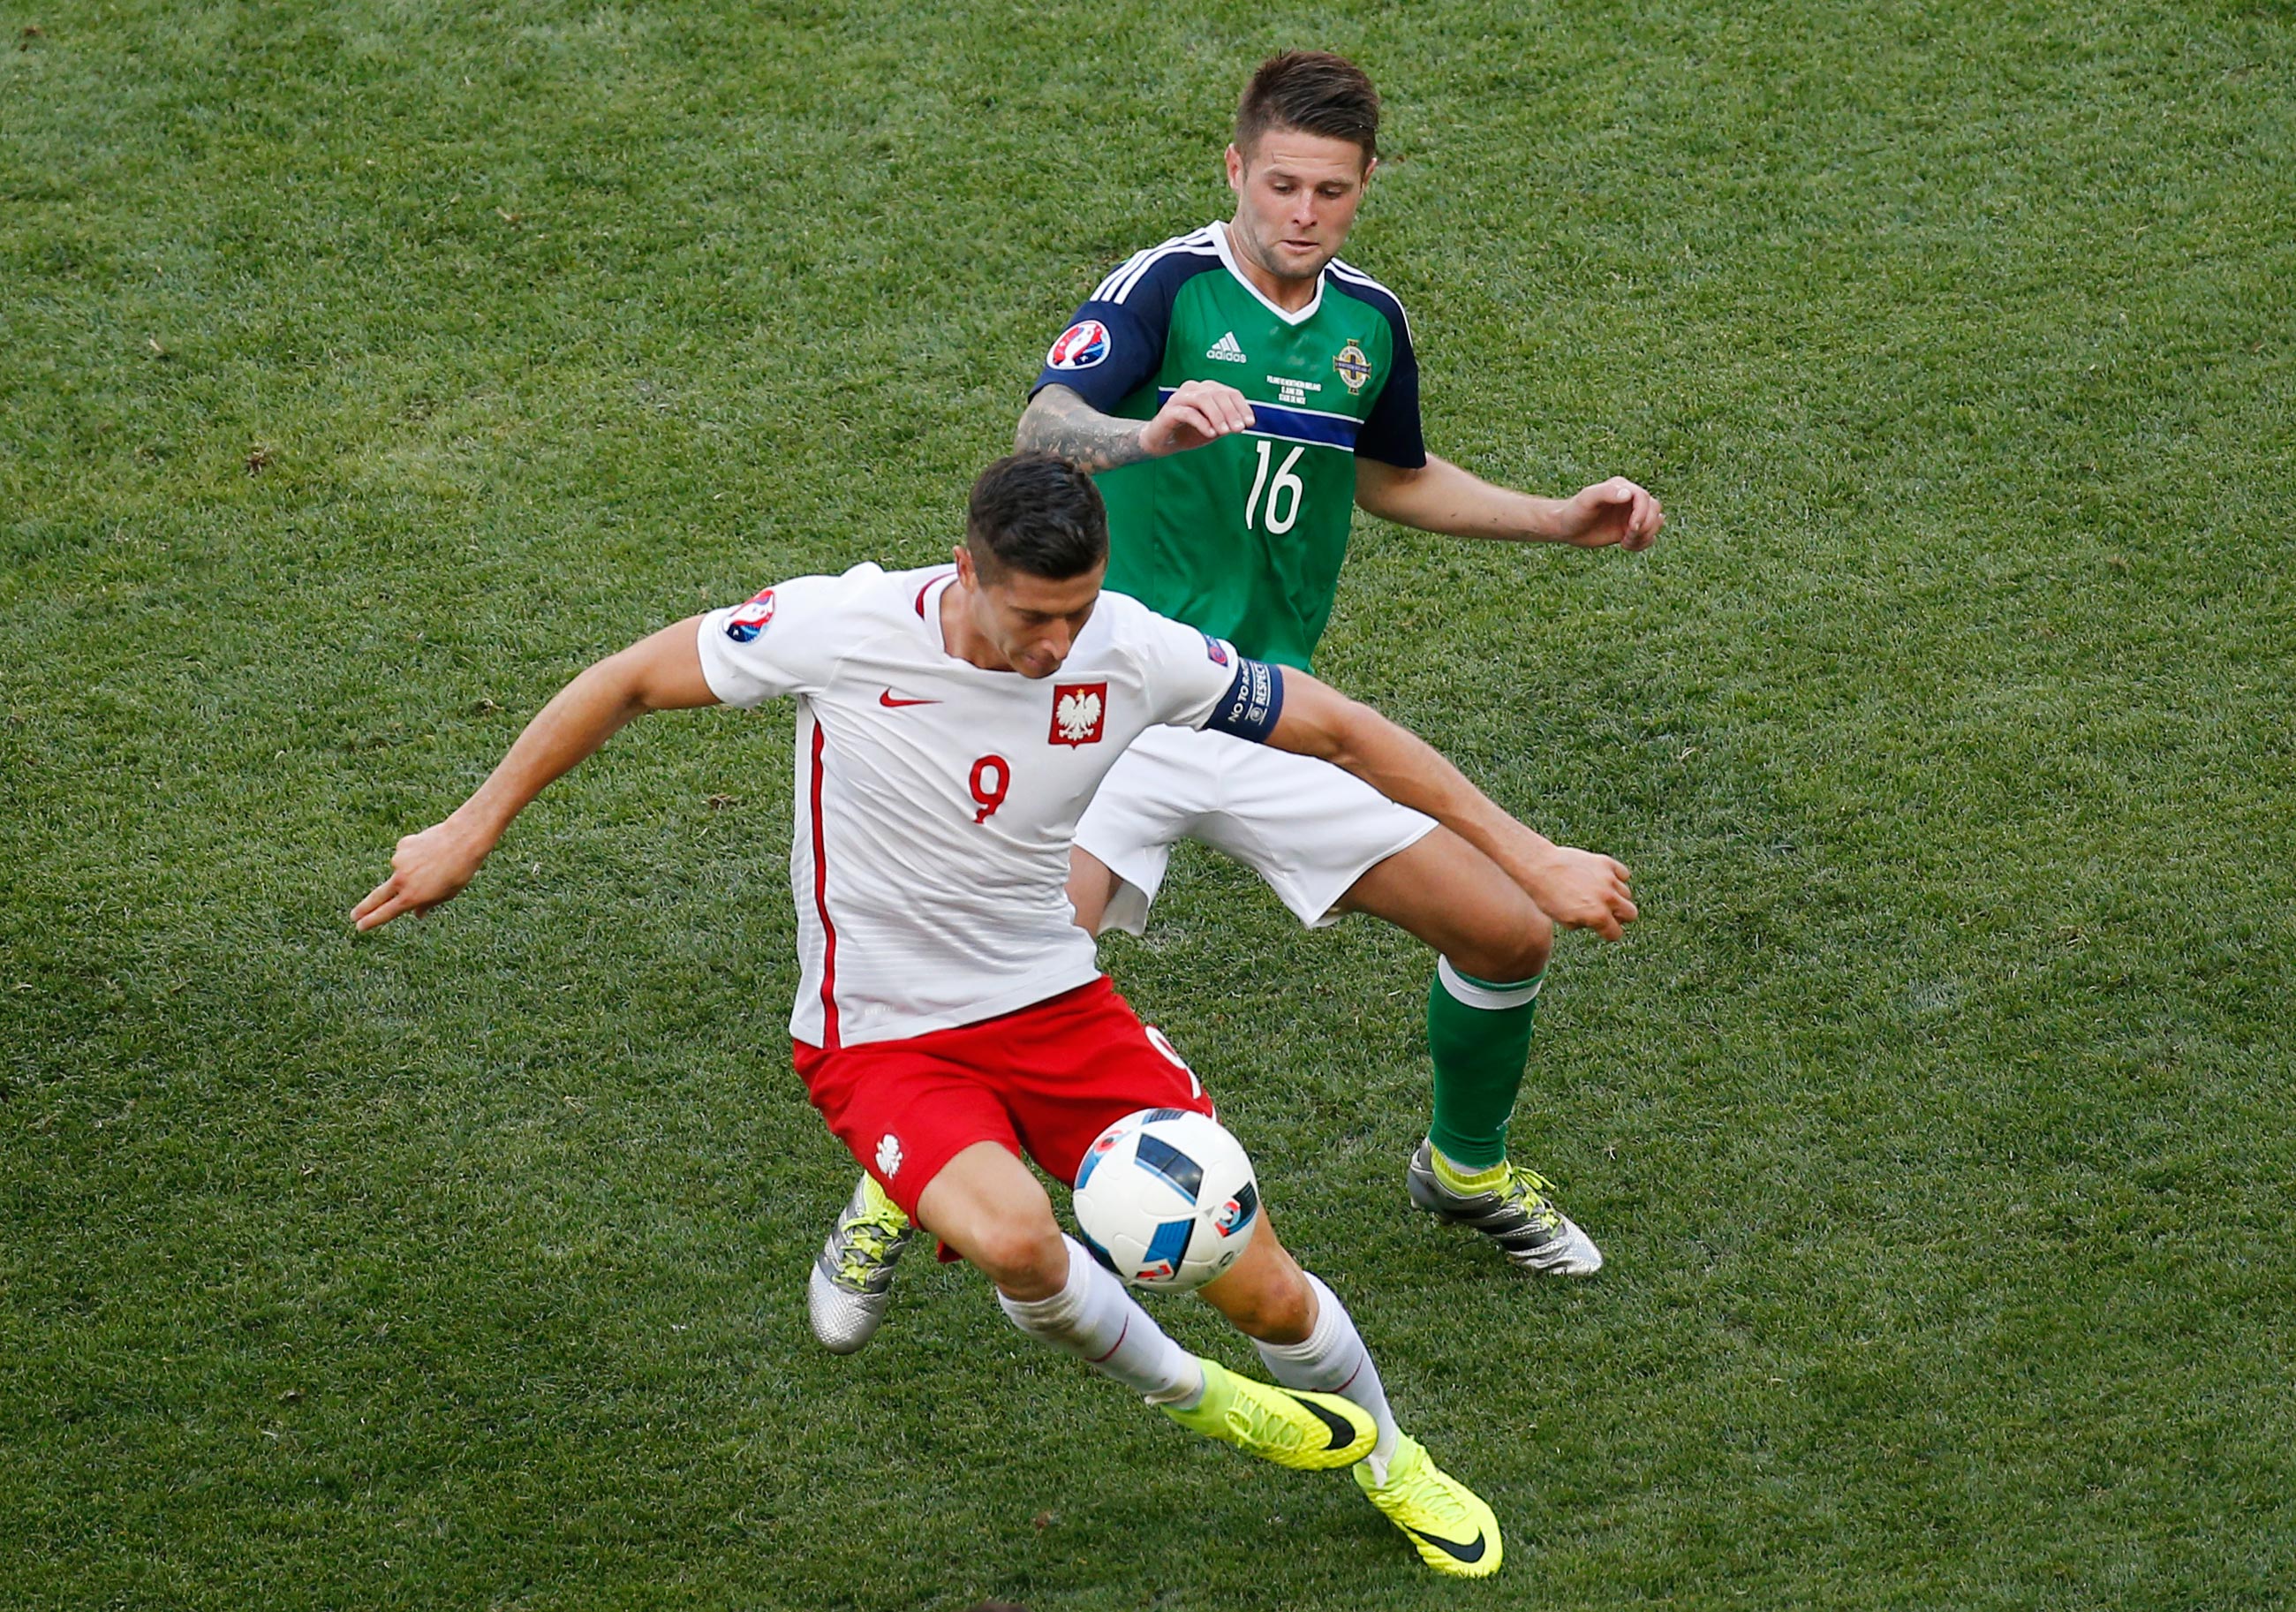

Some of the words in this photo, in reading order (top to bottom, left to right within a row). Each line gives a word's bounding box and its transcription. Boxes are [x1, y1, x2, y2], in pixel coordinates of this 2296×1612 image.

[1206, 350, 1247, 363] adidas
[1245, 440, 1305, 534] 16
[1227, 702, 1243, 722] NO
[1237, 685, 1249, 701] TO
[969, 754, 1009, 824] 9
[1144, 1025, 1201, 1099] 9
